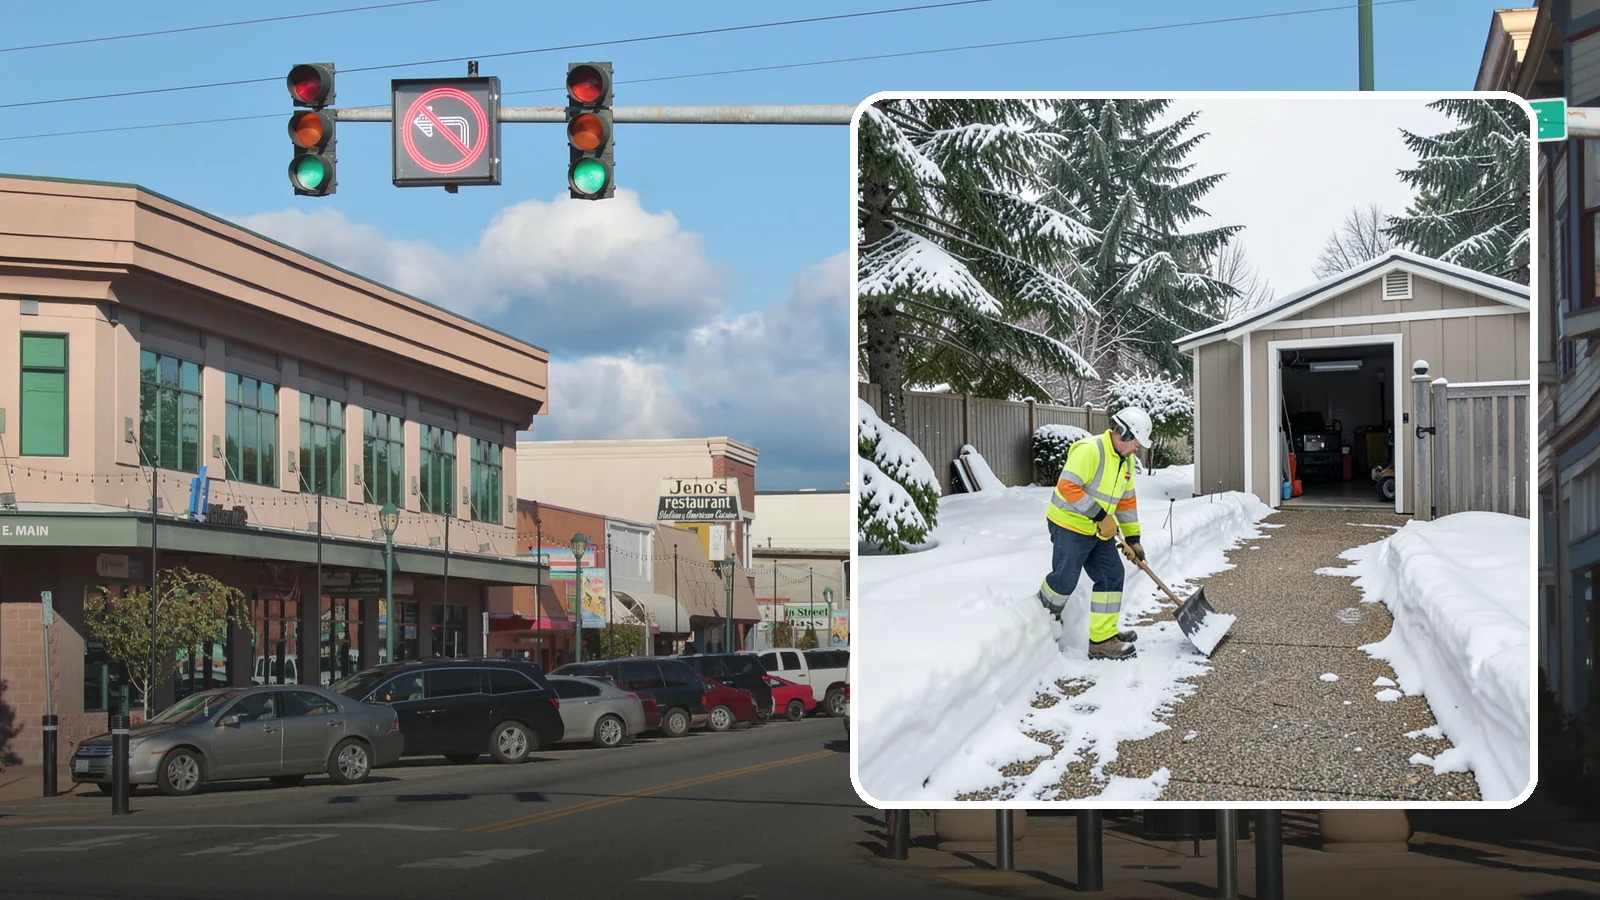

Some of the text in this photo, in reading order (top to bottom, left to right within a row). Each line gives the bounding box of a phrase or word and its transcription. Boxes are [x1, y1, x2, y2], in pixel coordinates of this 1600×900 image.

[670, 480, 727, 494] Jeno's
[665, 496, 731, 509] restaurant
[658, 510, 682, 519] Italian
[686, 510, 714, 519] American
[715, 509, 737, 519] Cuisine
[2, 525, 49, 536] E. MAIN
[797, 607, 828, 616] Street
[791, 619, 824, 627] lass
